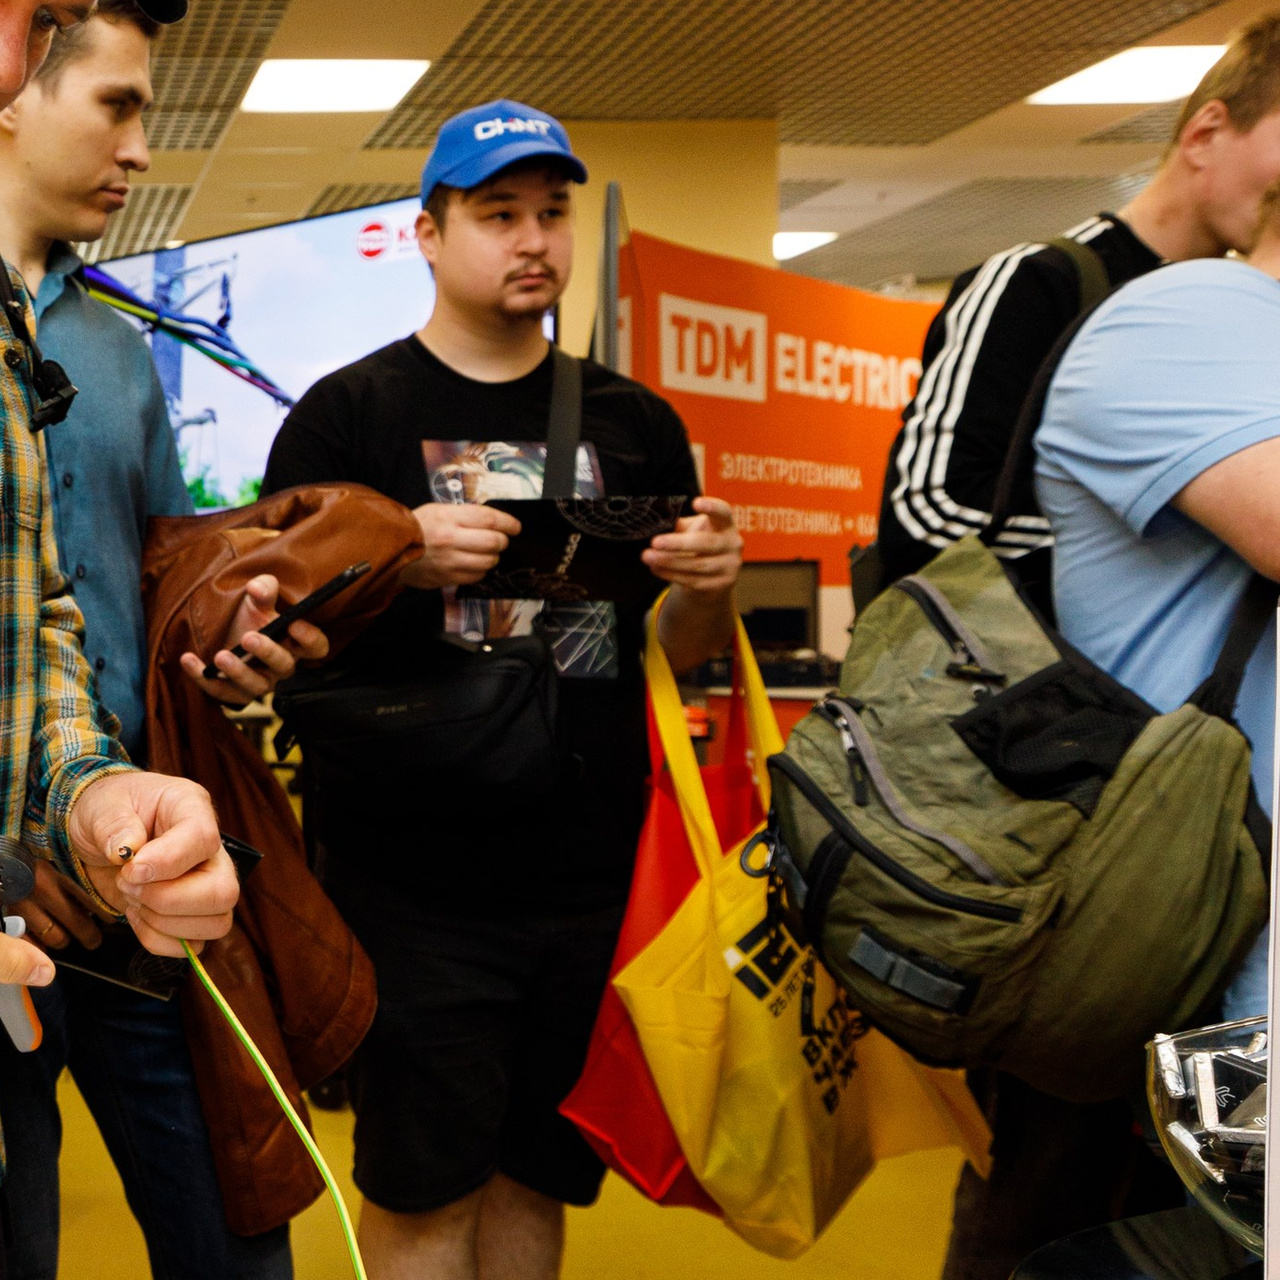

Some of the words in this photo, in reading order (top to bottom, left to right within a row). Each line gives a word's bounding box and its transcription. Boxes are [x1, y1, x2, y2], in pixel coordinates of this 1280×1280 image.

[670, 313, 754, 384] TDM
[776, 332, 922, 410] ELECTRIC
[721, 452, 862, 490] ЭЛЕКТРОТЕХНИКА
[733, 505, 841, 536] ВЕТОТЕХНИКА
